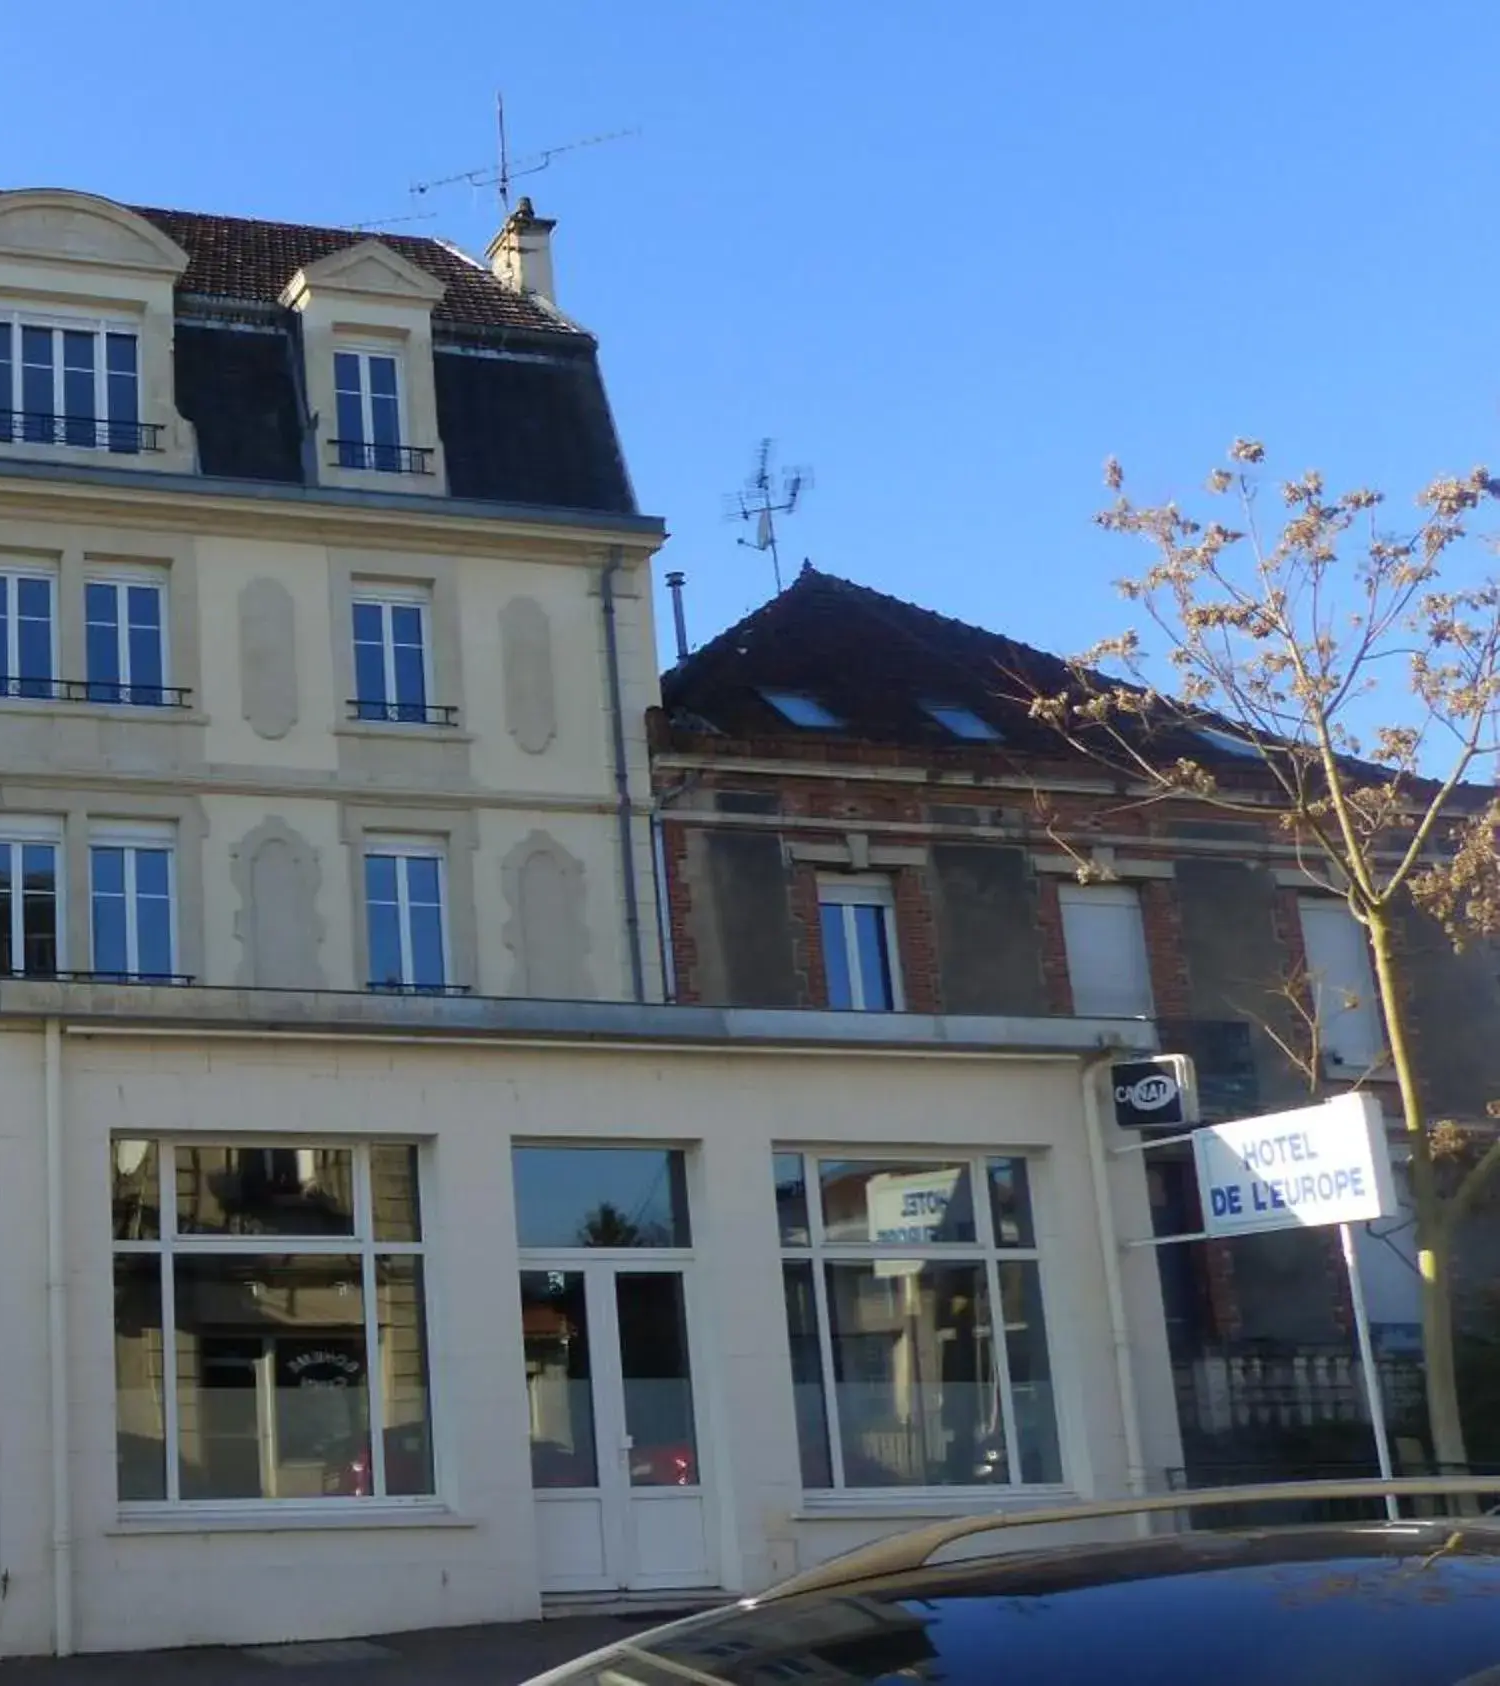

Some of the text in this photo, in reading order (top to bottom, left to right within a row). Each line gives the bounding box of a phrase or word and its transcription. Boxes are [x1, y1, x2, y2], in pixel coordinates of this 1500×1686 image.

[1241, 1131, 1318, 1171] HOTEL
[1211, 1166, 1366, 1217] DE L'EUROPE
